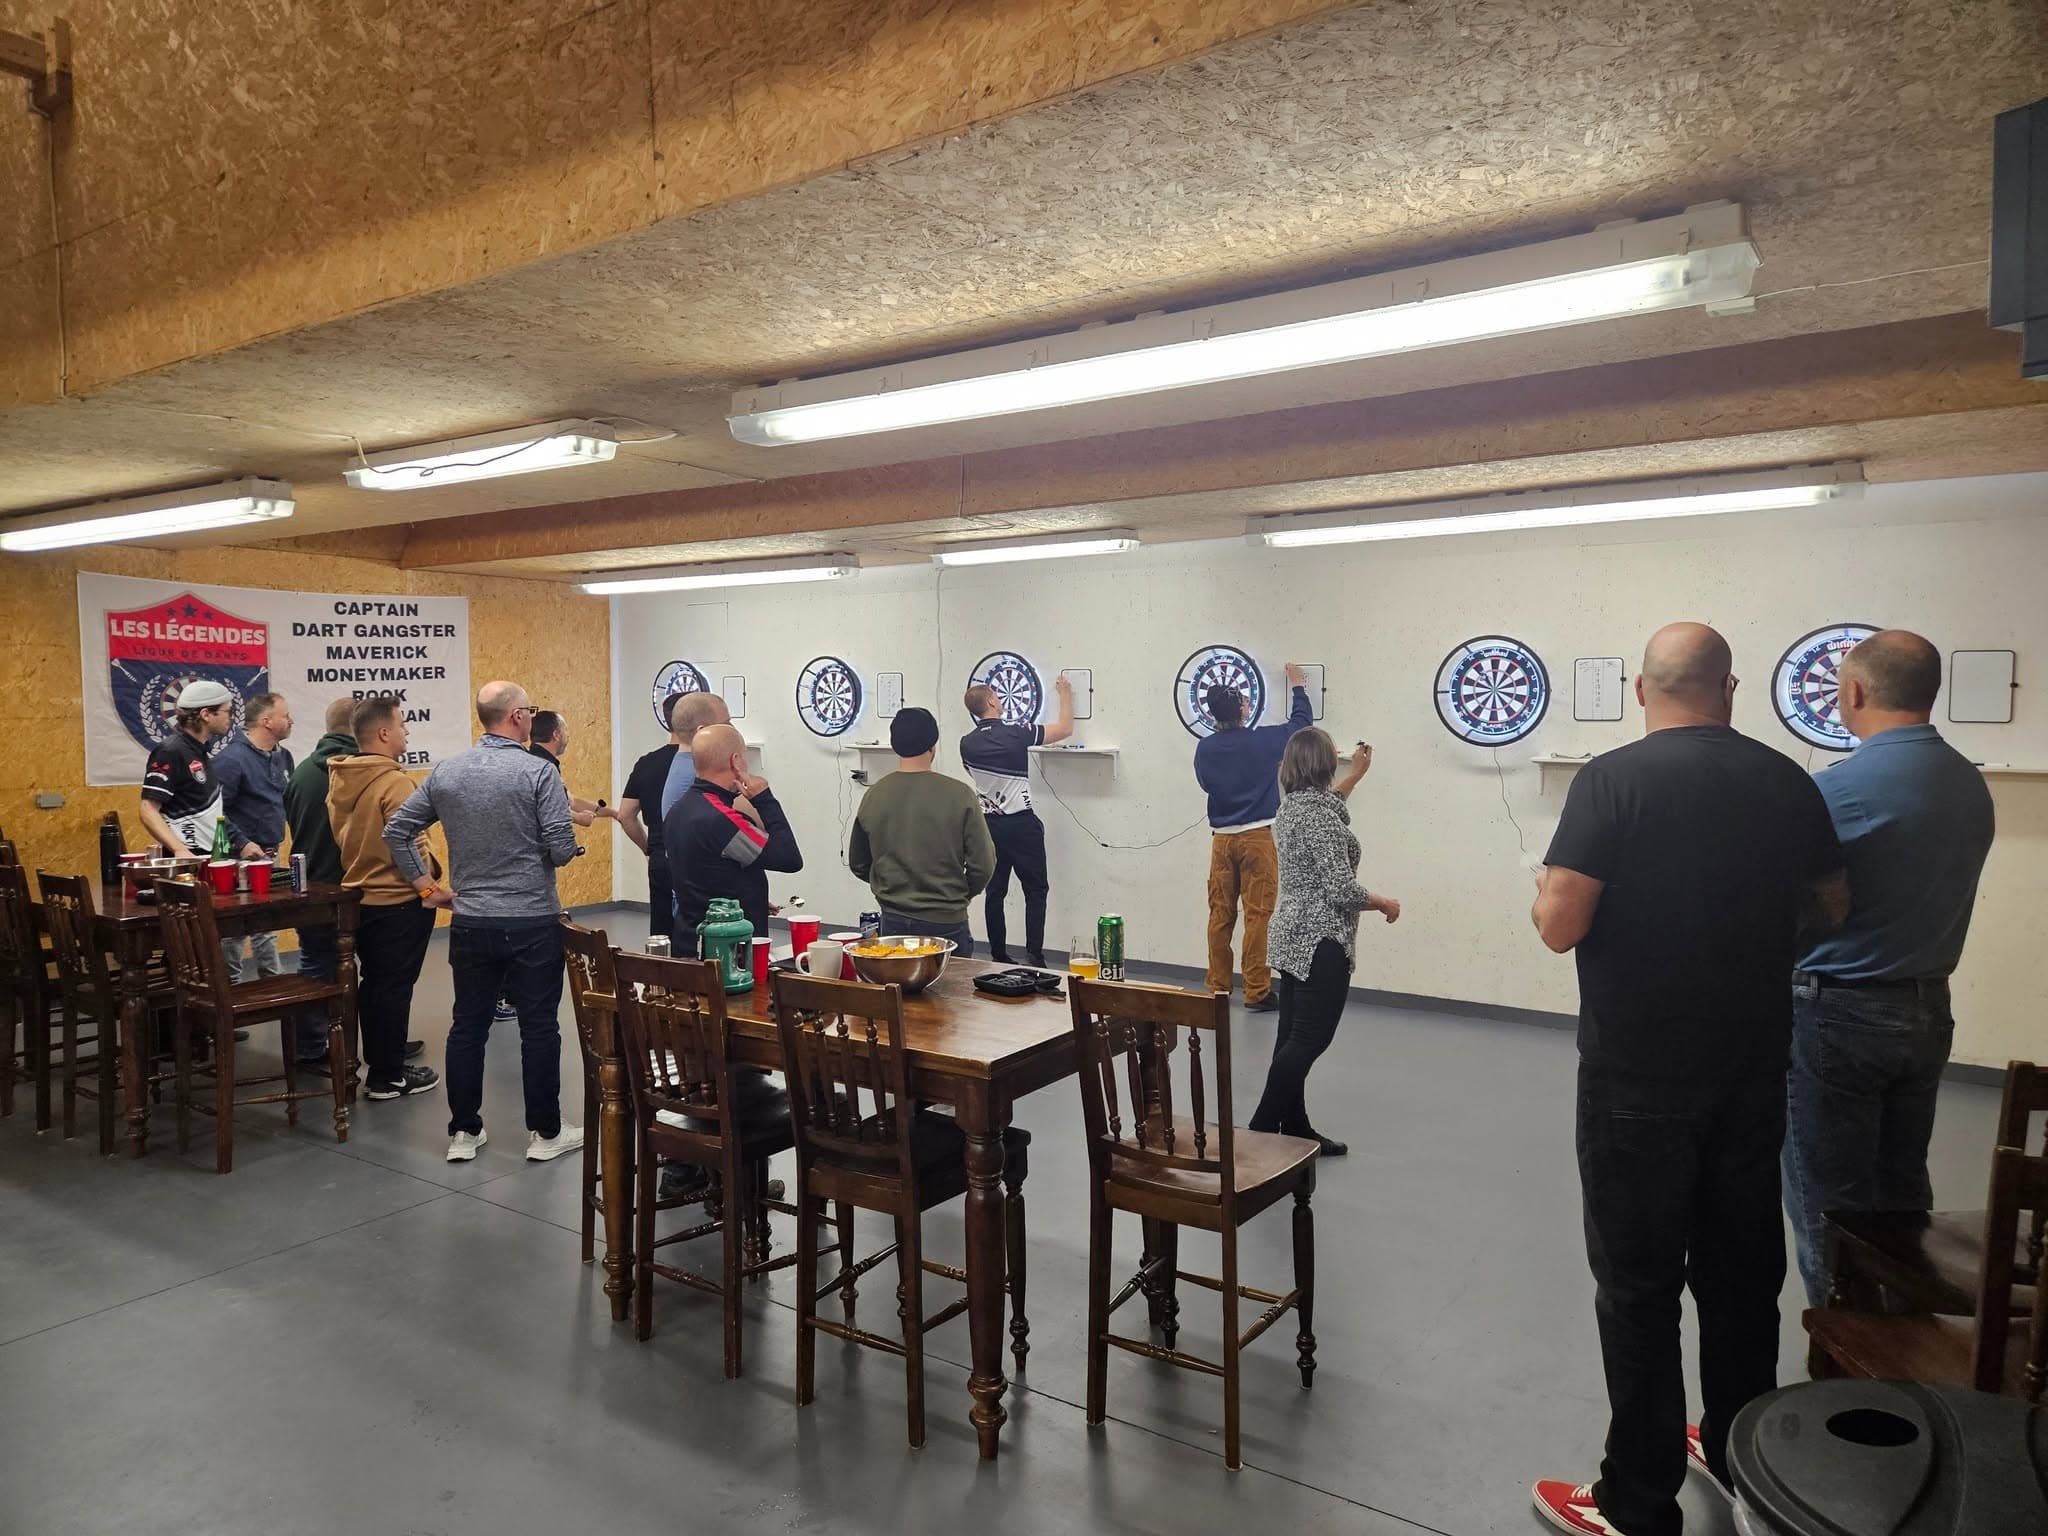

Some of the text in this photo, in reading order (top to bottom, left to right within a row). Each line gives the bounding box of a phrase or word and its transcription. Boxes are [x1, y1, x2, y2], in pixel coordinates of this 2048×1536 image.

[334, 601, 419, 617] CAPTAIN
[110, 618, 266, 645] LES LÉGENDES
[292, 622, 456, 638] DART GANGSTER
[181, 650, 198, 658] DE
[205, 651, 248, 660] DARTS
[326, 645, 428, 660] MAVERICK
[307, 666, 446, 682] MONEYMAKER
